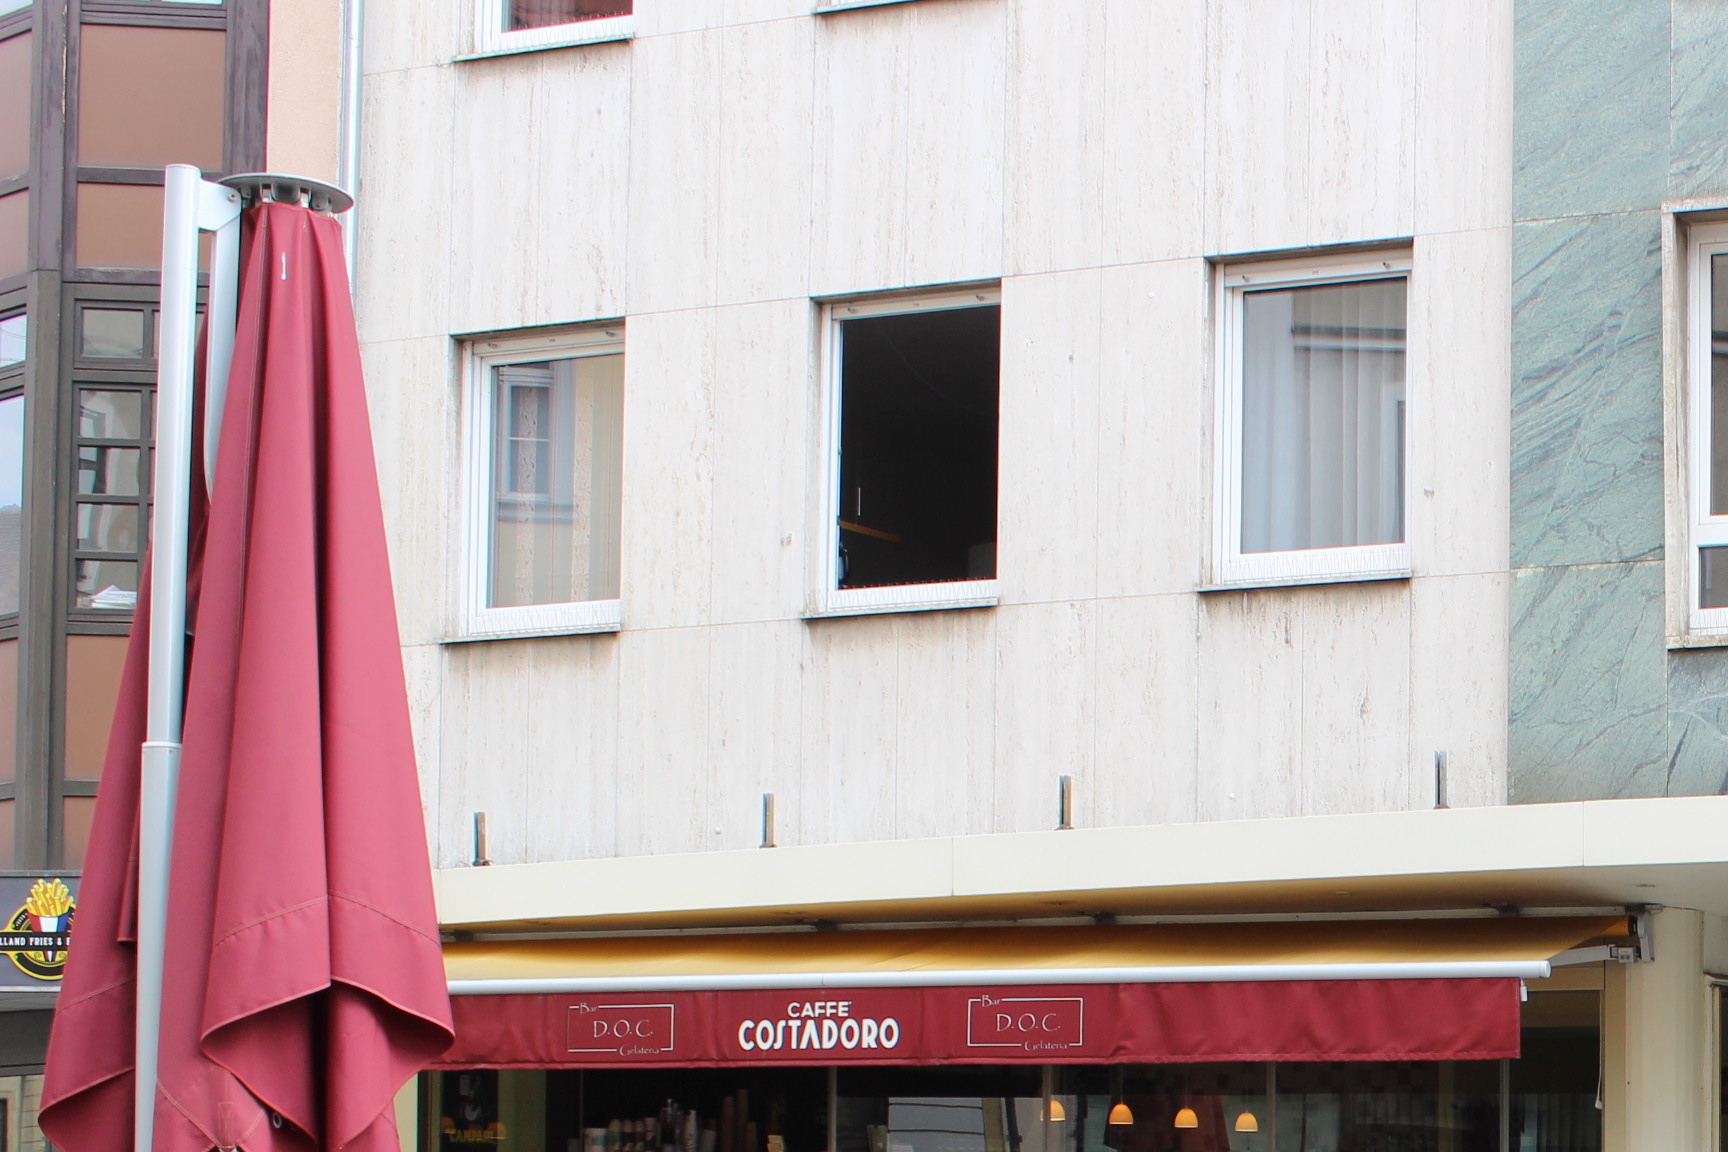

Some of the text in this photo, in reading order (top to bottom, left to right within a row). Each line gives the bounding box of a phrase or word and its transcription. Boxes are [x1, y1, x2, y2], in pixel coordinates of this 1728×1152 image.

[29, 937, 54, 947] FRIES
[578, 1001, 599, 1015] Bar
[980, 993, 1001, 1007] Bar
[592, 1018, 654, 1038] D.O.C.
[995, 1012, 1061, 1033] D.O.C.
[738, 1018, 900, 1051] COSTADORO
